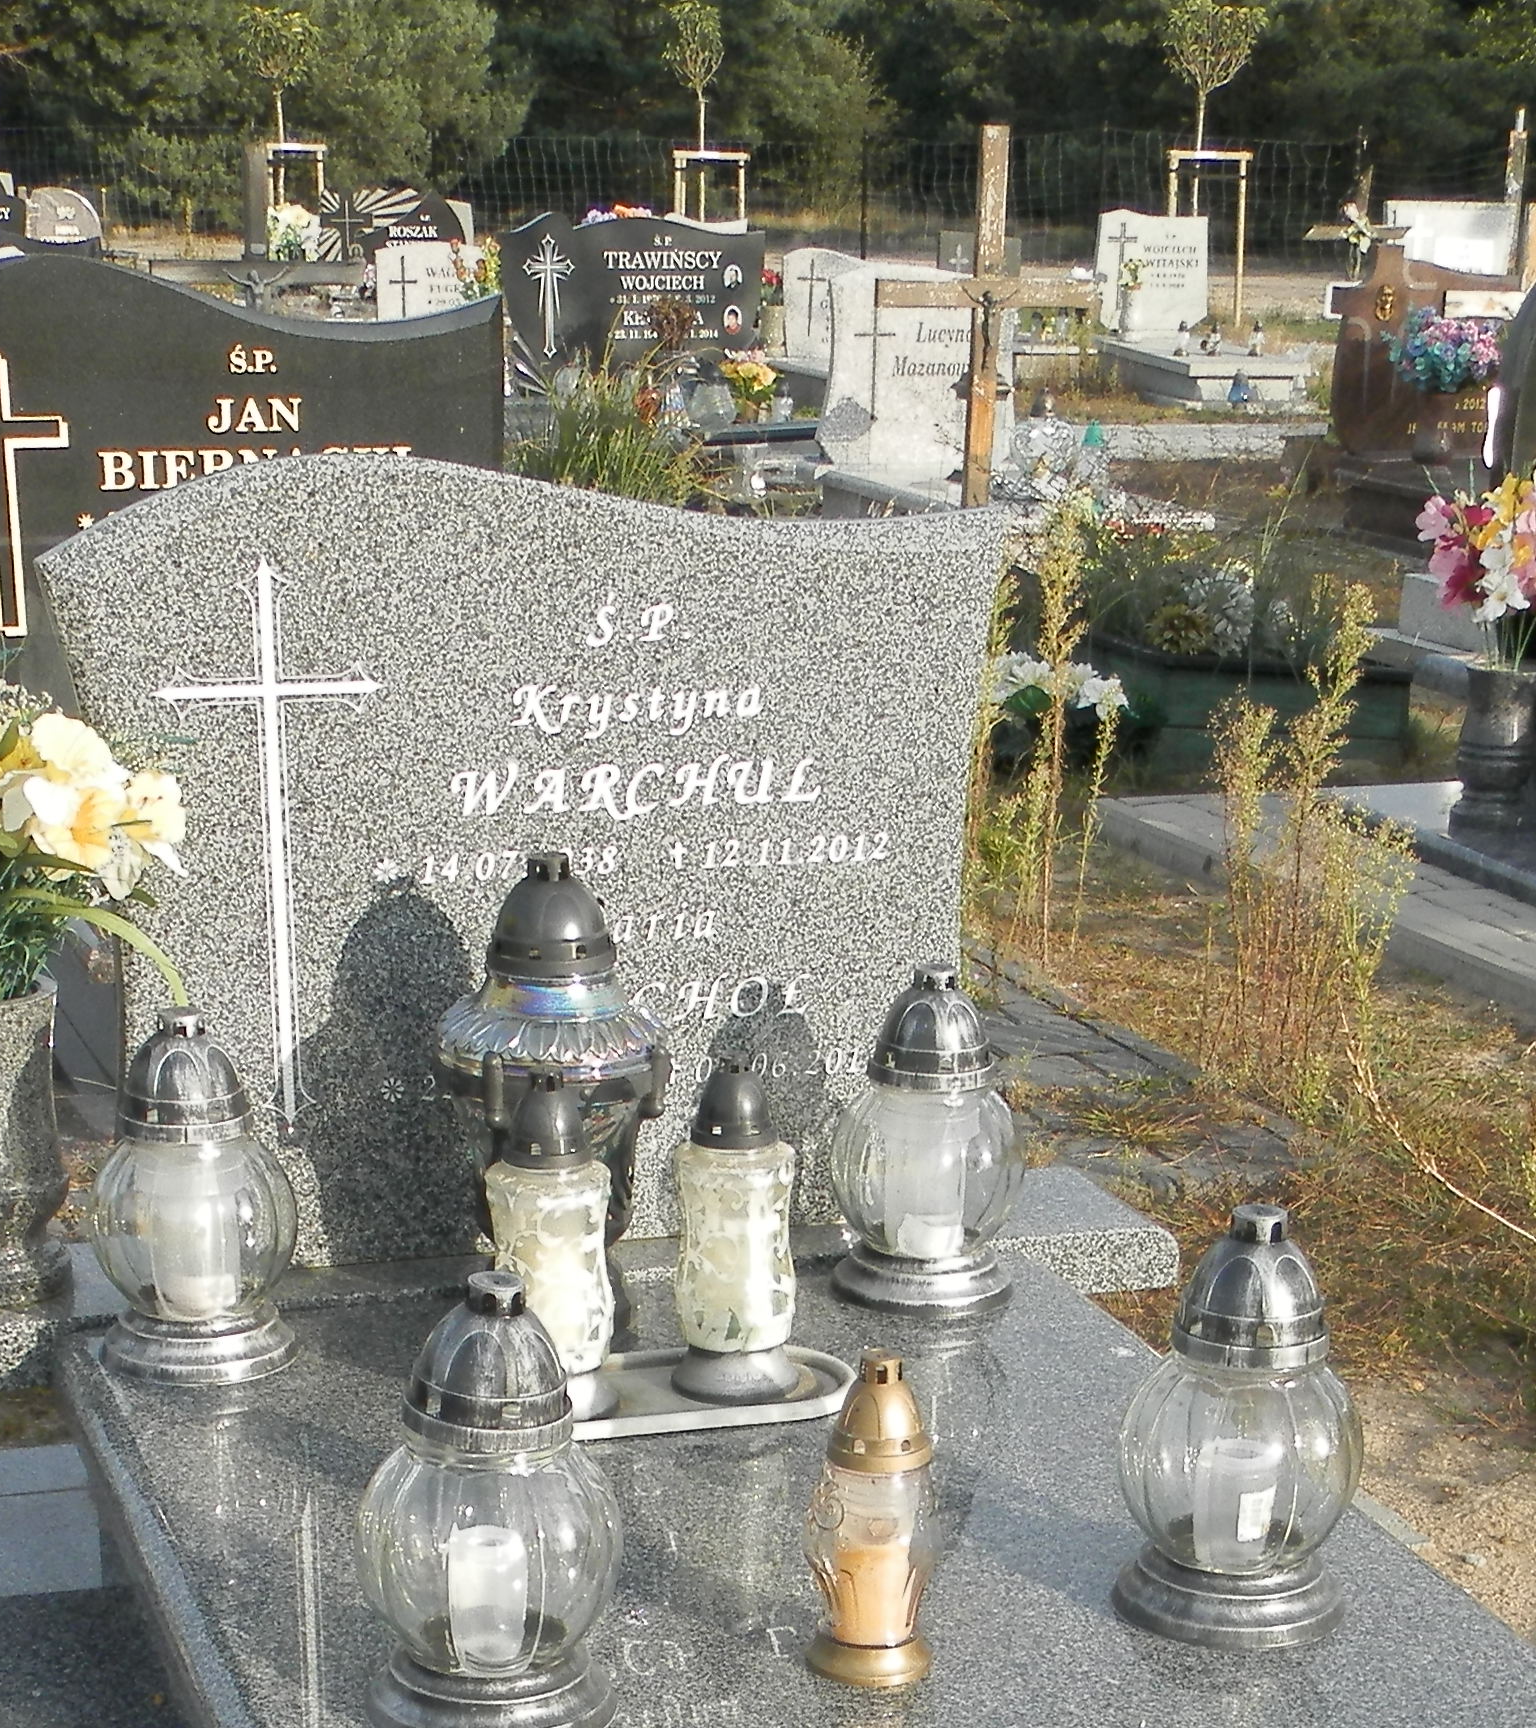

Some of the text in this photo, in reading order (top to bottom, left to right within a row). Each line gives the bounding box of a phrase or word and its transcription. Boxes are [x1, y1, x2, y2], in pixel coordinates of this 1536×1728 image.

[388, 225, 438, 238] ROSZAK
[603, 249, 723, 270] TRAWIŃSCY
[1145, 258, 1199, 268] WITAJSKI
[620, 275, 706, 291] WOJCIECH
[694, 295, 716, 305] 2012
[206, 396, 303, 434] JAN
[509, 683, 764, 737] Krystyna
[613, 901, 715, 945] aria
[628, 971, 816, 1024] CHOŁ
